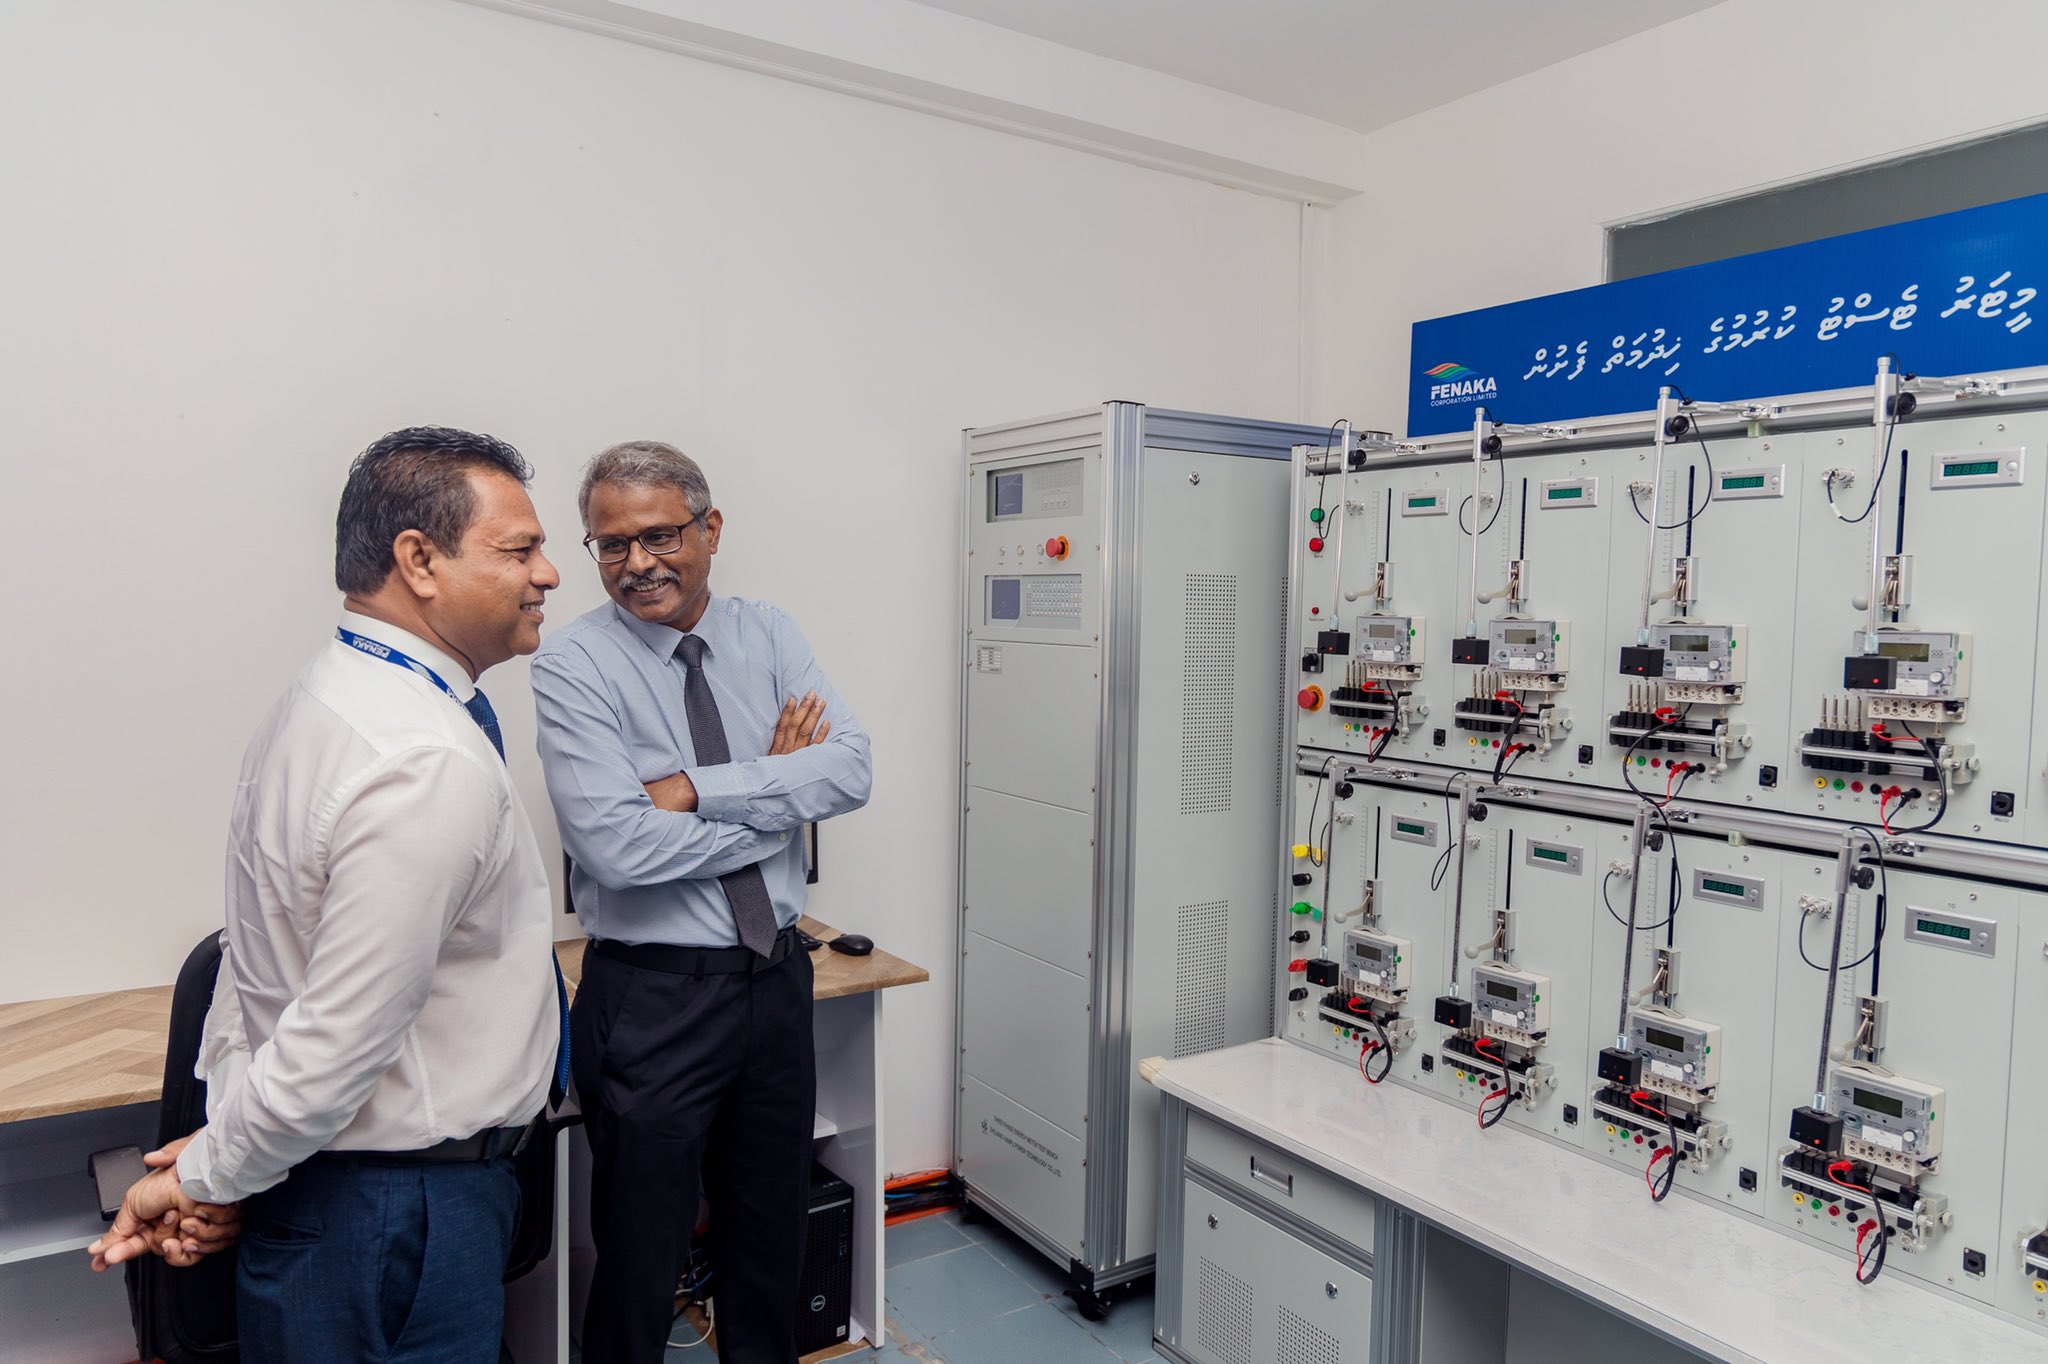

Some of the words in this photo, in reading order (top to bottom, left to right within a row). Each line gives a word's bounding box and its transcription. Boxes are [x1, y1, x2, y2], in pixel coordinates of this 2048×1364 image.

[1430, 377, 1497, 400] FENAKA
[1430, 396, 1472, 407] CORPORATION
[1472, 392, 1497, 401] LIMITED
[352, 635, 391, 659] FENAKA
